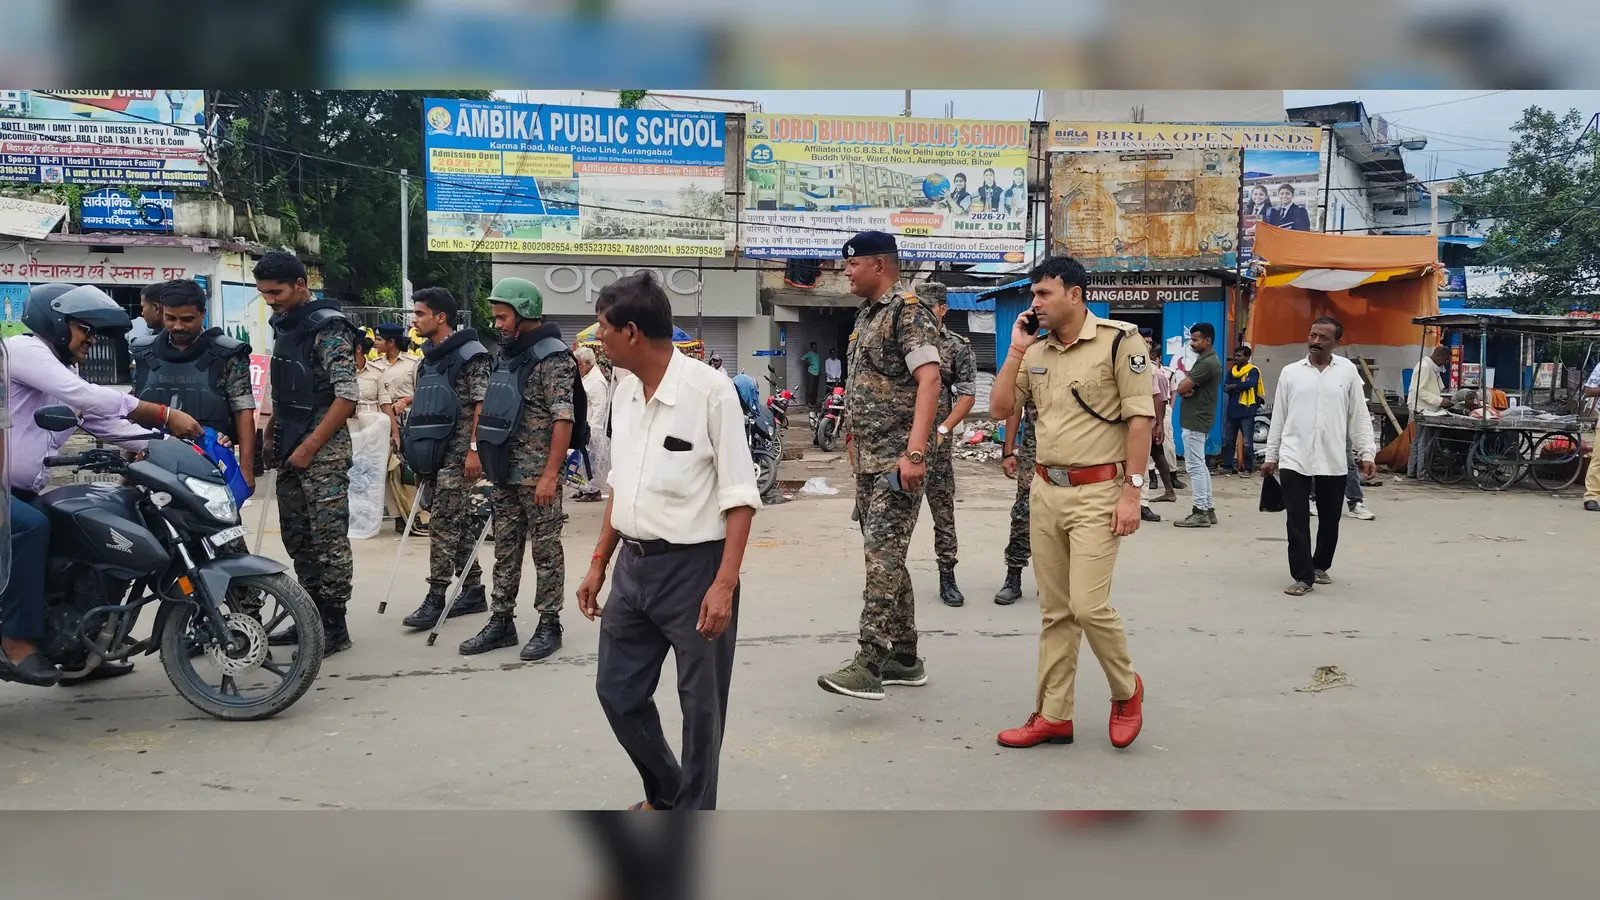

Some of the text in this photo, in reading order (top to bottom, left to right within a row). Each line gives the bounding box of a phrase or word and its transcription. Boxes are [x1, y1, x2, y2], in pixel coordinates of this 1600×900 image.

[118, 89, 152, 98] OPEN
[1, 121, 20, 130] BOTT
[29, 123, 45, 131] BHM
[53, 124, 72, 132] DMLT
[79, 124, 98, 133] DOTA
[105, 125, 137, 134] DRESSER
[144, 127, 164, 137] X-ray
[455, 107, 723, 148] AMBIKA PUBLIC SCHOOL
[769, 118, 1027, 150] LORD BUDDHA PUBLIC SCHOOL
[1096, 130, 1314, 144] BIRLA OPEN MINDS
[98, 135, 113, 144] BCA
[120, 136, 131, 144] BA
[137, 137, 154, 145] B.Sc
[161, 138, 184, 146] B.Com
[490, 141, 673, 157] Karma Road, Near Police Line, Aurangabad
[753, 149, 770, 160] 25
[804, 144, 841, 153] Affiliated
[843, 145, 852, 153] to
[892, 147, 911, 155] New
[912, 148, 934, 156] Delhi
[935, 149, 954, 159] upto
[957, 149, 977, 158] 10+2
[978, 150, 1001, 158] Level
[432, 150, 500, 162] Admission Open
[811, 153, 838, 161] Buddh
[840, 154, 864, 162] Vihar,
[866, 155, 888, 163] Ward
[917, 157, 969, 166] Aurangabad,
[98, 159, 133, 168] Transport
[134, 160, 161, 169] Facility
[438, 158, 492, 168] 2026-27
[65, 169, 71, 177] A
[73, 169, 89, 177] unit
[91, 169, 99, 177] of
[126, 170, 150, 179] Group
[152, 171, 160, 179] of
[162, 171, 208, 181] Institutions
[582, 164, 618, 173] Affiliated
[620, 165, 628, 173] to
[663, 166, 680, 175] New
[683, 168, 703, 176] Delhi
[894, 216, 941, 225] ADMISSION
[954, 221, 1022, 231] Nur. to IX
[905, 227, 929, 235] OPEN
[431, 239, 723, 255] Cont. No.- 7992207712, 8002082654, 9835237352, 7482002041, 9525795492
[900, 240, 1024, 252] Grand Tradition of Excellence
[18, 257, 186, 282] शौचालय स्नान घर
[1121, 275, 1162, 286] CEMENT
[1166, 275, 1197, 286] PLANT
[1086, 290, 1200, 301] RANGABAD POLICE
